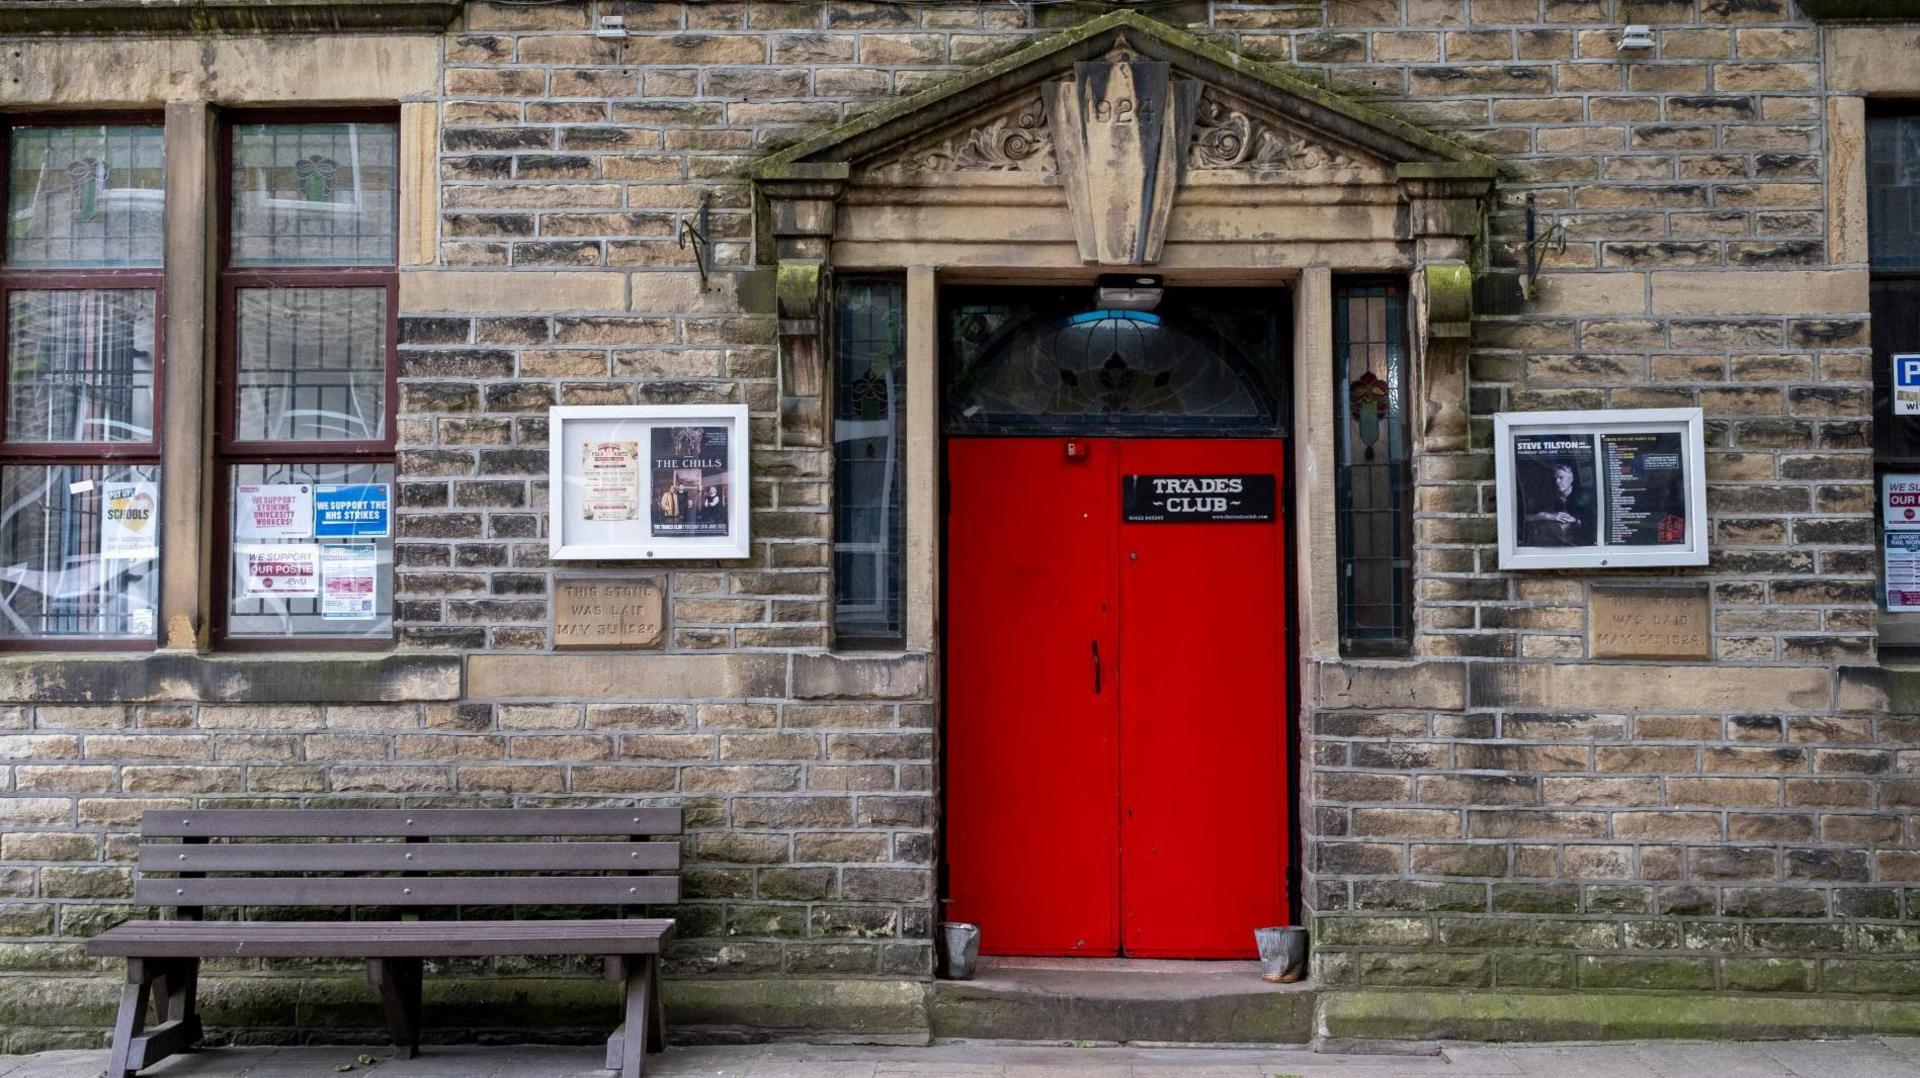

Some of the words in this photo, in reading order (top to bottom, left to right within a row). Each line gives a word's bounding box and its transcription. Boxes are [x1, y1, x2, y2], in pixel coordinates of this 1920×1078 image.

[1905, 361, 1920, 384] P
[1517, 442, 1542, 450] STEVE
[1543, 441, 1578, 450] TILSTON
[656, 459, 678, 468] THE
[682, 459, 722, 468] CHILLS
[1153, 478, 1243, 494] TRADES
[1889, 483, 1906, 491] WE
[264, 496, 296, 504] SUPPORT
[1891, 496, 1915, 505] OUR
[317, 502, 329, 510] WE
[330, 501, 368, 510] SUPPORT
[370, 501, 387, 510] THE
[1166, 498, 1228, 513] CLUB
[107, 509, 149, 520] SCHOOLS
[254, 511, 295, 519] UNIVERSITY
[325, 511, 342, 520] NHS
[344, 511, 380, 520] STRIKES
[249, 553, 266, 561] WE
[267, 552, 312, 561] SUPPORT
[250, 565, 273, 574] OUR
[275, 565, 313, 574] POSTIE
[565, 586, 597, 597] THIS
[605, 586, 652, 597] STONE
[572, 605, 602, 616] WAS
[557, 624, 591, 635] MAY
